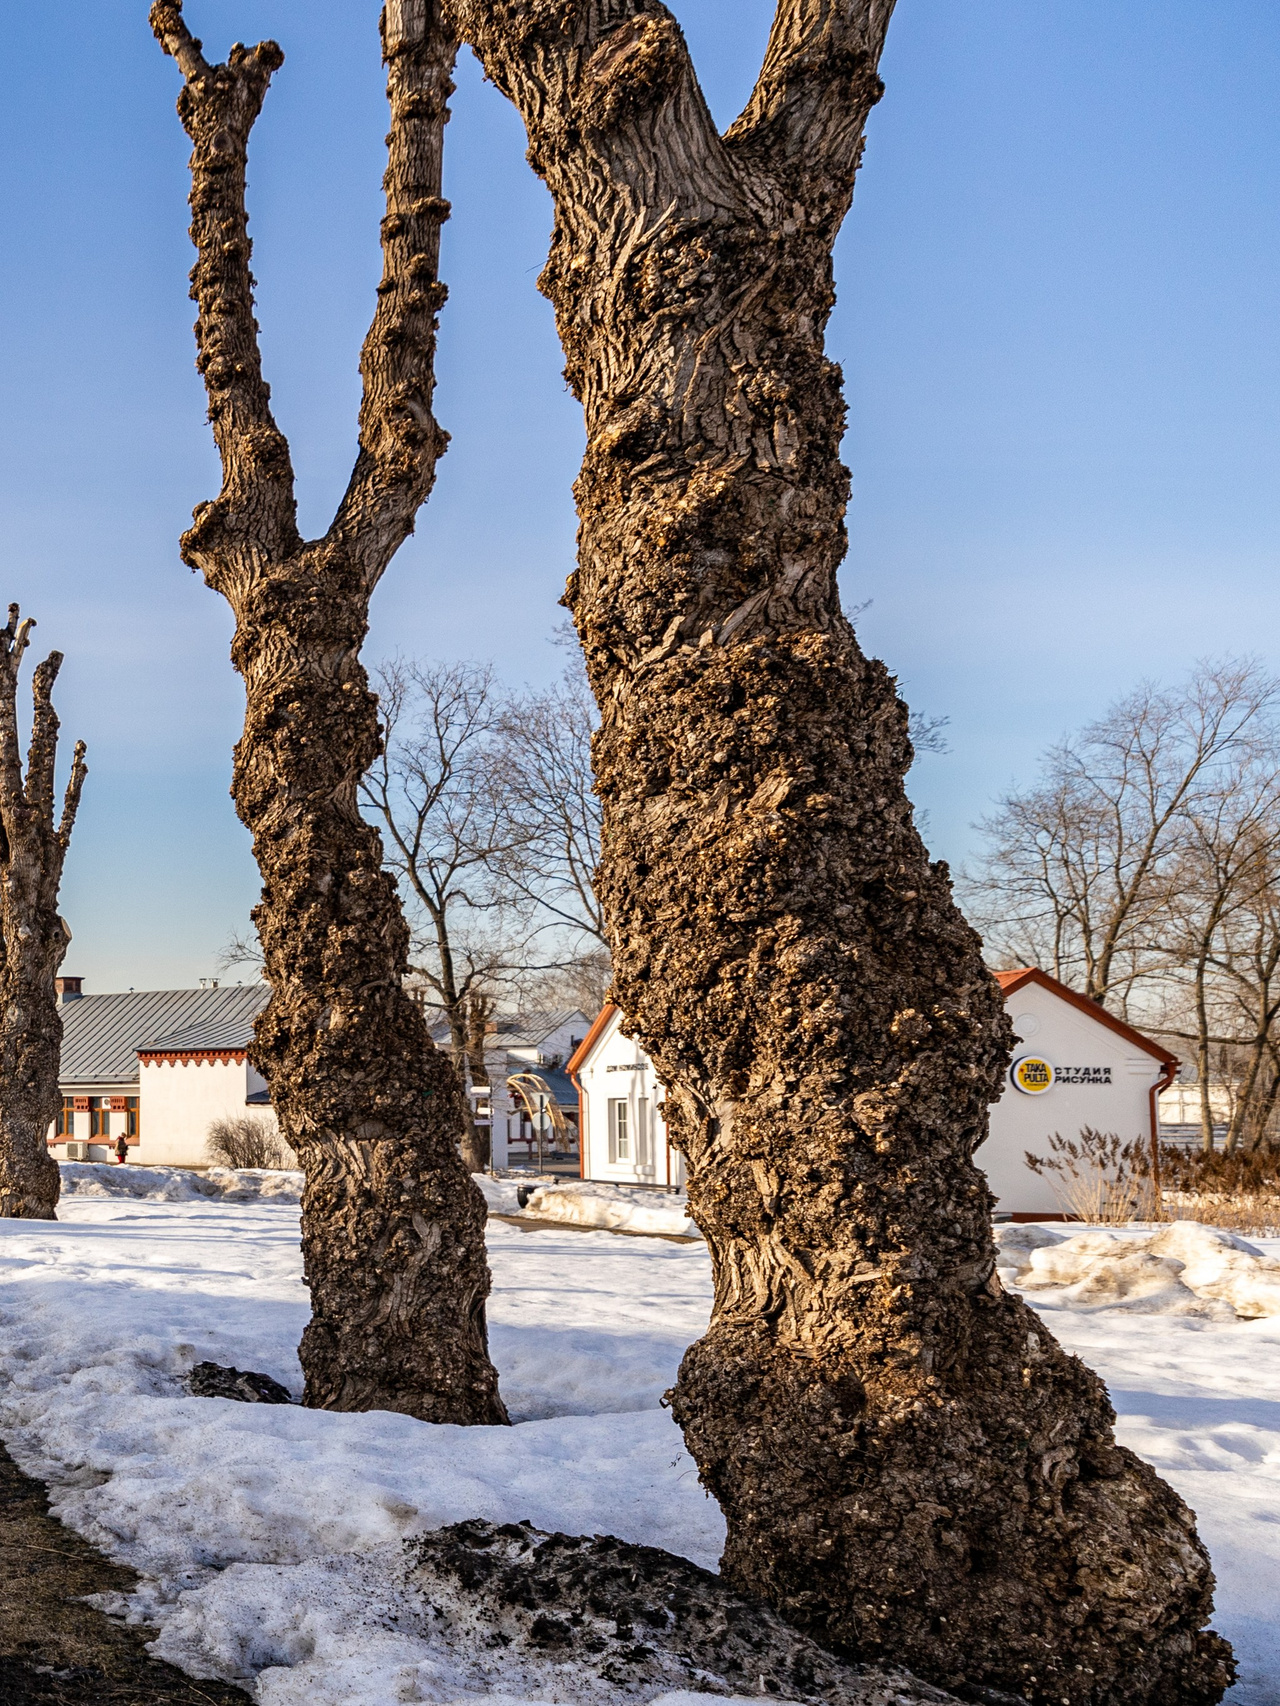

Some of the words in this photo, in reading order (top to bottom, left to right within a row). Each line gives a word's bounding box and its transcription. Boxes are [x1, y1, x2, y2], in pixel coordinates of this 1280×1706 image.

[1054, 1067, 1111, 1076] СТУДИЯ
[1023, 1073, 1049, 1083] PULTA
[1054, 1076, 1112, 1084] РИСУНКА
